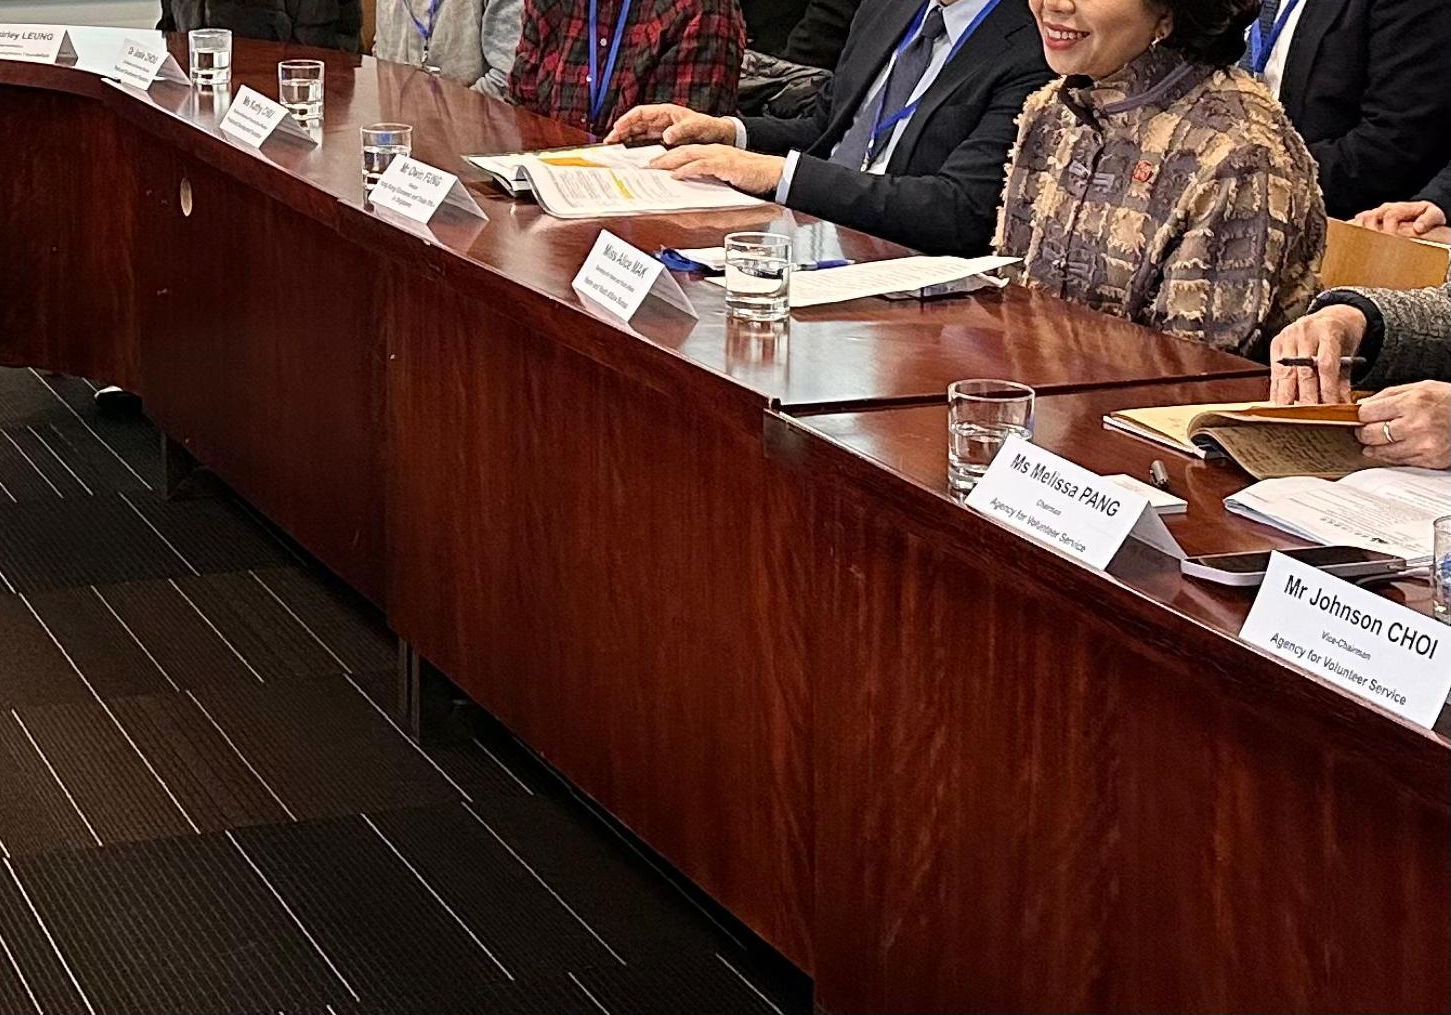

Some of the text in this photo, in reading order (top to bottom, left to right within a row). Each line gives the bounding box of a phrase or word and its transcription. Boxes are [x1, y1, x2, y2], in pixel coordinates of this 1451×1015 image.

[22, 31, 54, 41] LEUNG
[602, 243, 618, 262] Miss
[616, 251, 633, 271] Alice
[631, 259, 649, 279] MAK
[1010, 453, 1121, 517] Ms Melissa PANG
[1035, 498, 1062, 517] Chairman
[989, 496, 1087, 553] Agency for Volunteer Service
[1283, 574, 1440, 660] Mr Johnson CHOI
[1321, 629, 1372, 661] Vice-Chairman
[1269, 632, 1408, 706] Agency for Volunteer Service
